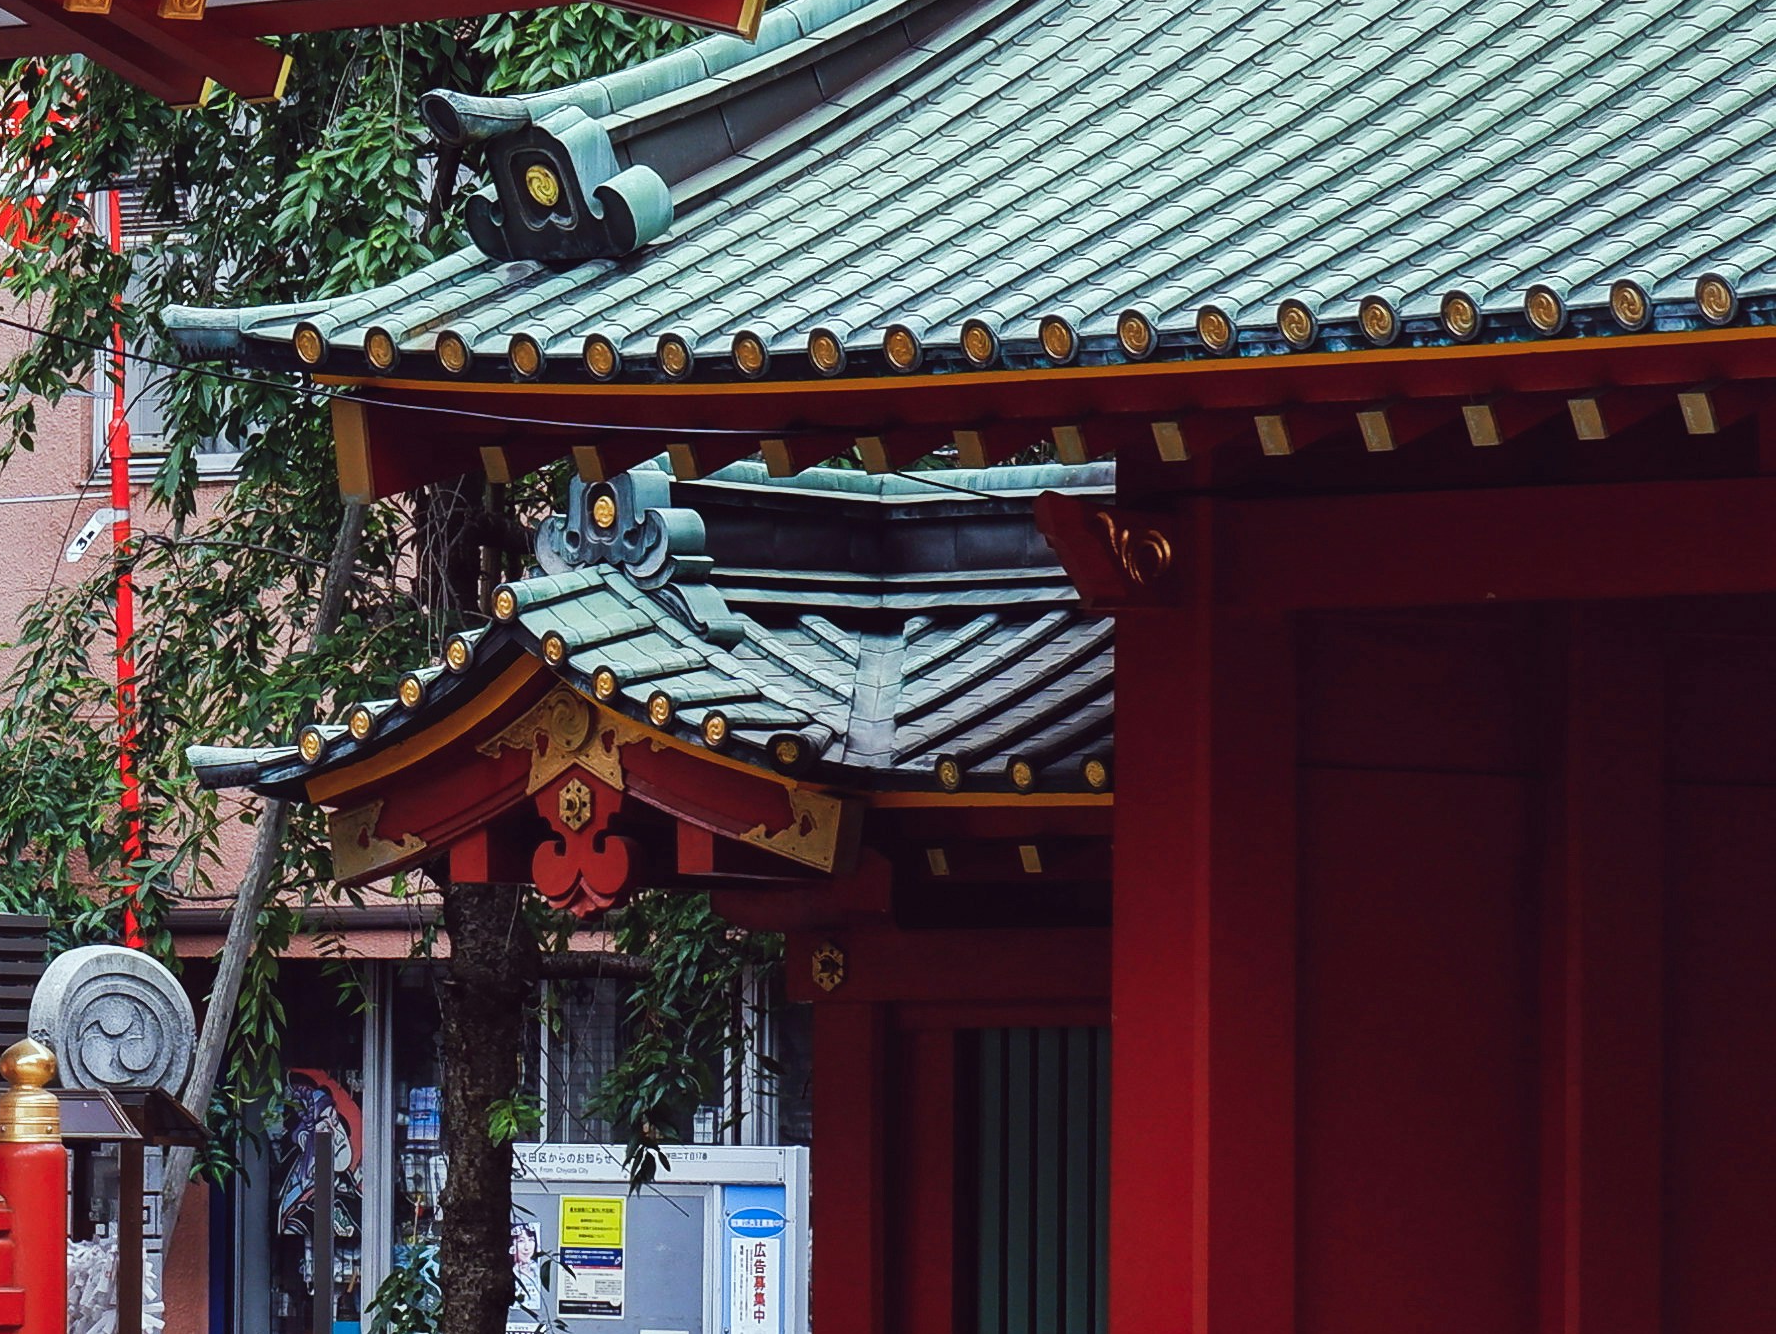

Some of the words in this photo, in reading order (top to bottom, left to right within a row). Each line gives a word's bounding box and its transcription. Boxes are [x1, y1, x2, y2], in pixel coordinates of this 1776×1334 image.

[753, 1242, 767, 1324] 広告募集中
